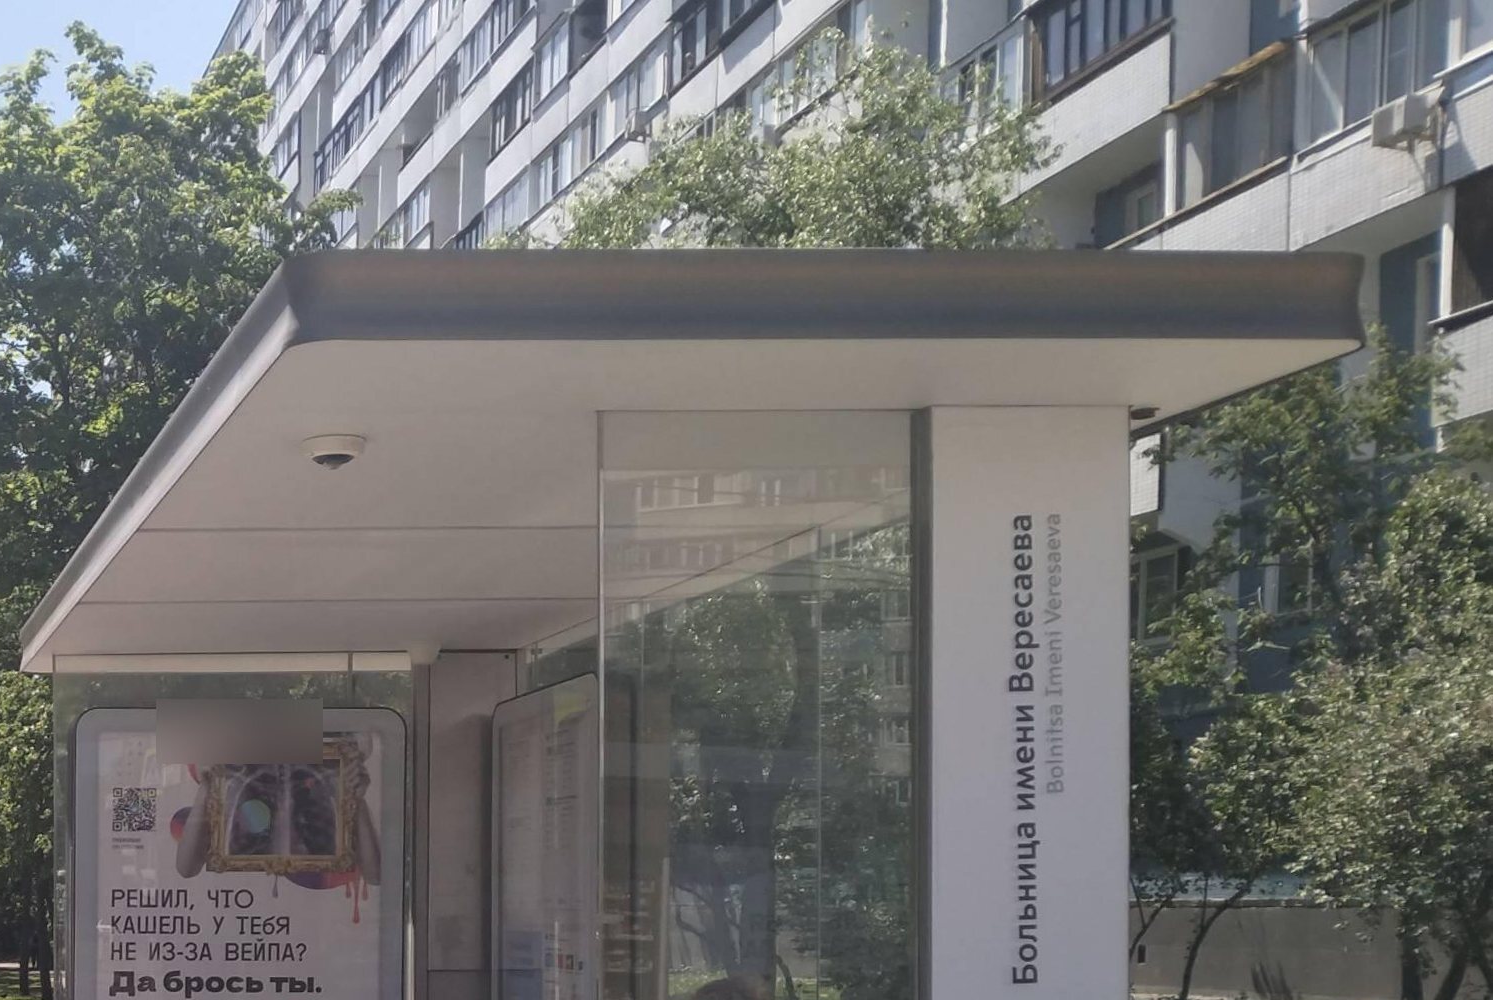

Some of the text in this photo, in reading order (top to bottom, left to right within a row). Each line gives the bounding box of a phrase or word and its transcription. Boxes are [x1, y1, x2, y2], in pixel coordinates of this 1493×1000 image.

[1043, 513, 1064, 794] Bolnitsa Imeni Veresaeva
[1009, 514, 1040, 985] Больница имени Вересаева
[111, 888, 254, 910] РЕШИЛ, ЧТО
[110, 915, 201, 935] КАШЕЛЬ
[212, 916, 225, 935] У
[110, 938, 307, 962] НЕ ИЗ-ЗА ВЕЙПА?
[109, 970, 322, 998] Да брось ты.
